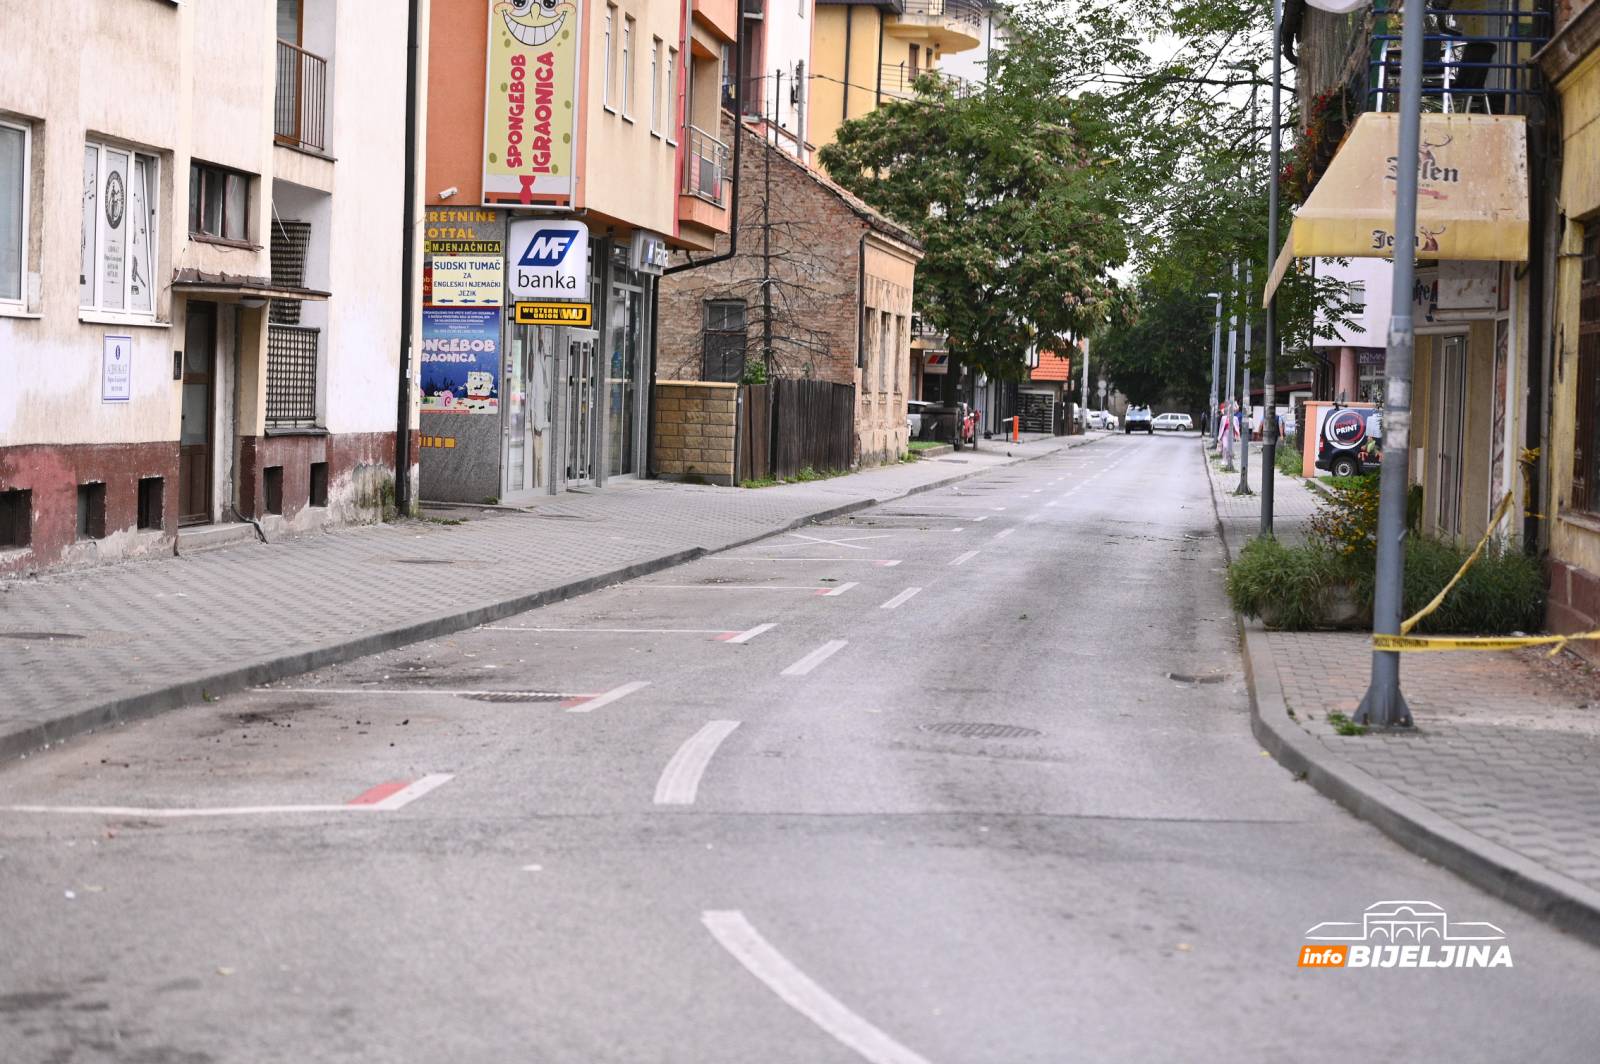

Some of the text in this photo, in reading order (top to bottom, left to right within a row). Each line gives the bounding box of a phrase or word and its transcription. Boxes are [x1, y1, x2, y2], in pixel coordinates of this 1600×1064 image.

[506, 53, 527, 169] SPONGEBOB
[532, 51, 555, 173] IGRAONICA
[527, 236, 571, 260] MF
[434, 259, 501, 271] SUDSKI TUMAČ
[518, 269, 576, 289] banka
[422, 338, 495, 353] NGEBOB
[1336, 423, 1358, 435] PRINT
